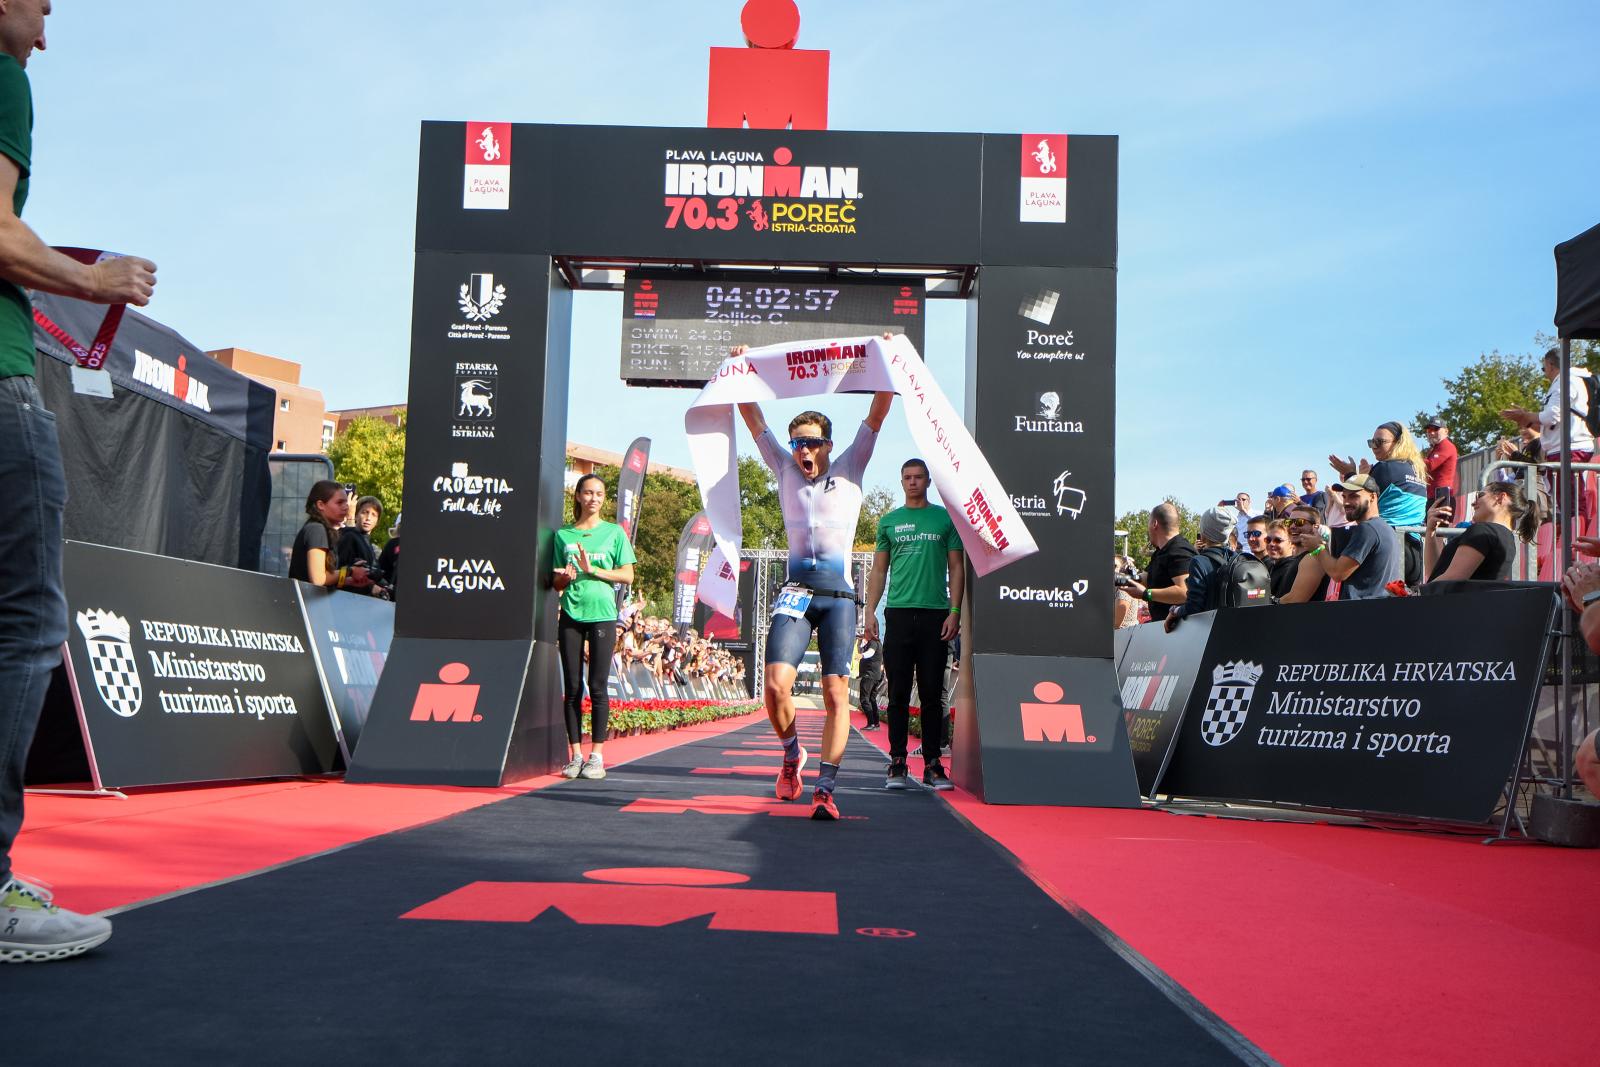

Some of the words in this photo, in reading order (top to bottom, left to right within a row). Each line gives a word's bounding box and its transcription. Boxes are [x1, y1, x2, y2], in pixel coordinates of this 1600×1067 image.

[666, 150, 705, 161] PLAVA
[711, 151, 763, 164] LAGUNA
[665, 147, 859, 199] IRONMAN
[469, 187, 504, 195] LAGUNA
[665, 197, 738, 230] 70.3
[772, 200, 857, 223] POREČ
[1025, 200, 1060, 208] LAGUNA
[772, 224, 857, 234] ISTRIA-CROATIA
[706, 286, 839, 311] 04:02:57
[1027, 330, 1074, 346] Poreč
[786, 342, 868, 366] IRONMAN
[1017, 350, 1032, 359] You
[1033, 350, 1073, 363] complete
[456, 362, 498, 371] ISTARSKA
[788, 364, 818, 381] 70.3
[133, 349, 212, 413] IRONMAN
[891, 354, 926, 405] PLAVA
[926, 407, 961, 473] LAGUNA
[1014, 415, 1084, 433] Funtana
[452, 430, 495, 438] ISTRIANA
[433, 475, 513, 494] CROATIA
[441, 497, 466, 513] Full
[483, 498, 502, 519] life
[963, 497, 982, 526] 70.3
[972, 486, 1010, 552] IRONMAN
[437, 558, 495, 574] PLAVA
[427, 575, 505, 594] LAGUNA
[999, 585, 1074, 602] Podravka
[141, 620, 233, 647] REPUBLIKA
[231, 629, 305, 654] HRVATSKA
[148, 650, 266, 683] Ministarstvo
[1276, 663, 1386, 683] REPUBLIKA
[1391, 661, 1517, 682] HRVATSKA
[159, 687, 235, 714] turizma
[234, 688, 245, 713] i
[245, 693, 298, 721] sporta
[1266, 690, 1421, 718] Ministarstvo
[1257, 723, 1347, 749] turizma
[1352, 725, 1365, 750] i
[1366, 731, 1452, 758] sporta
